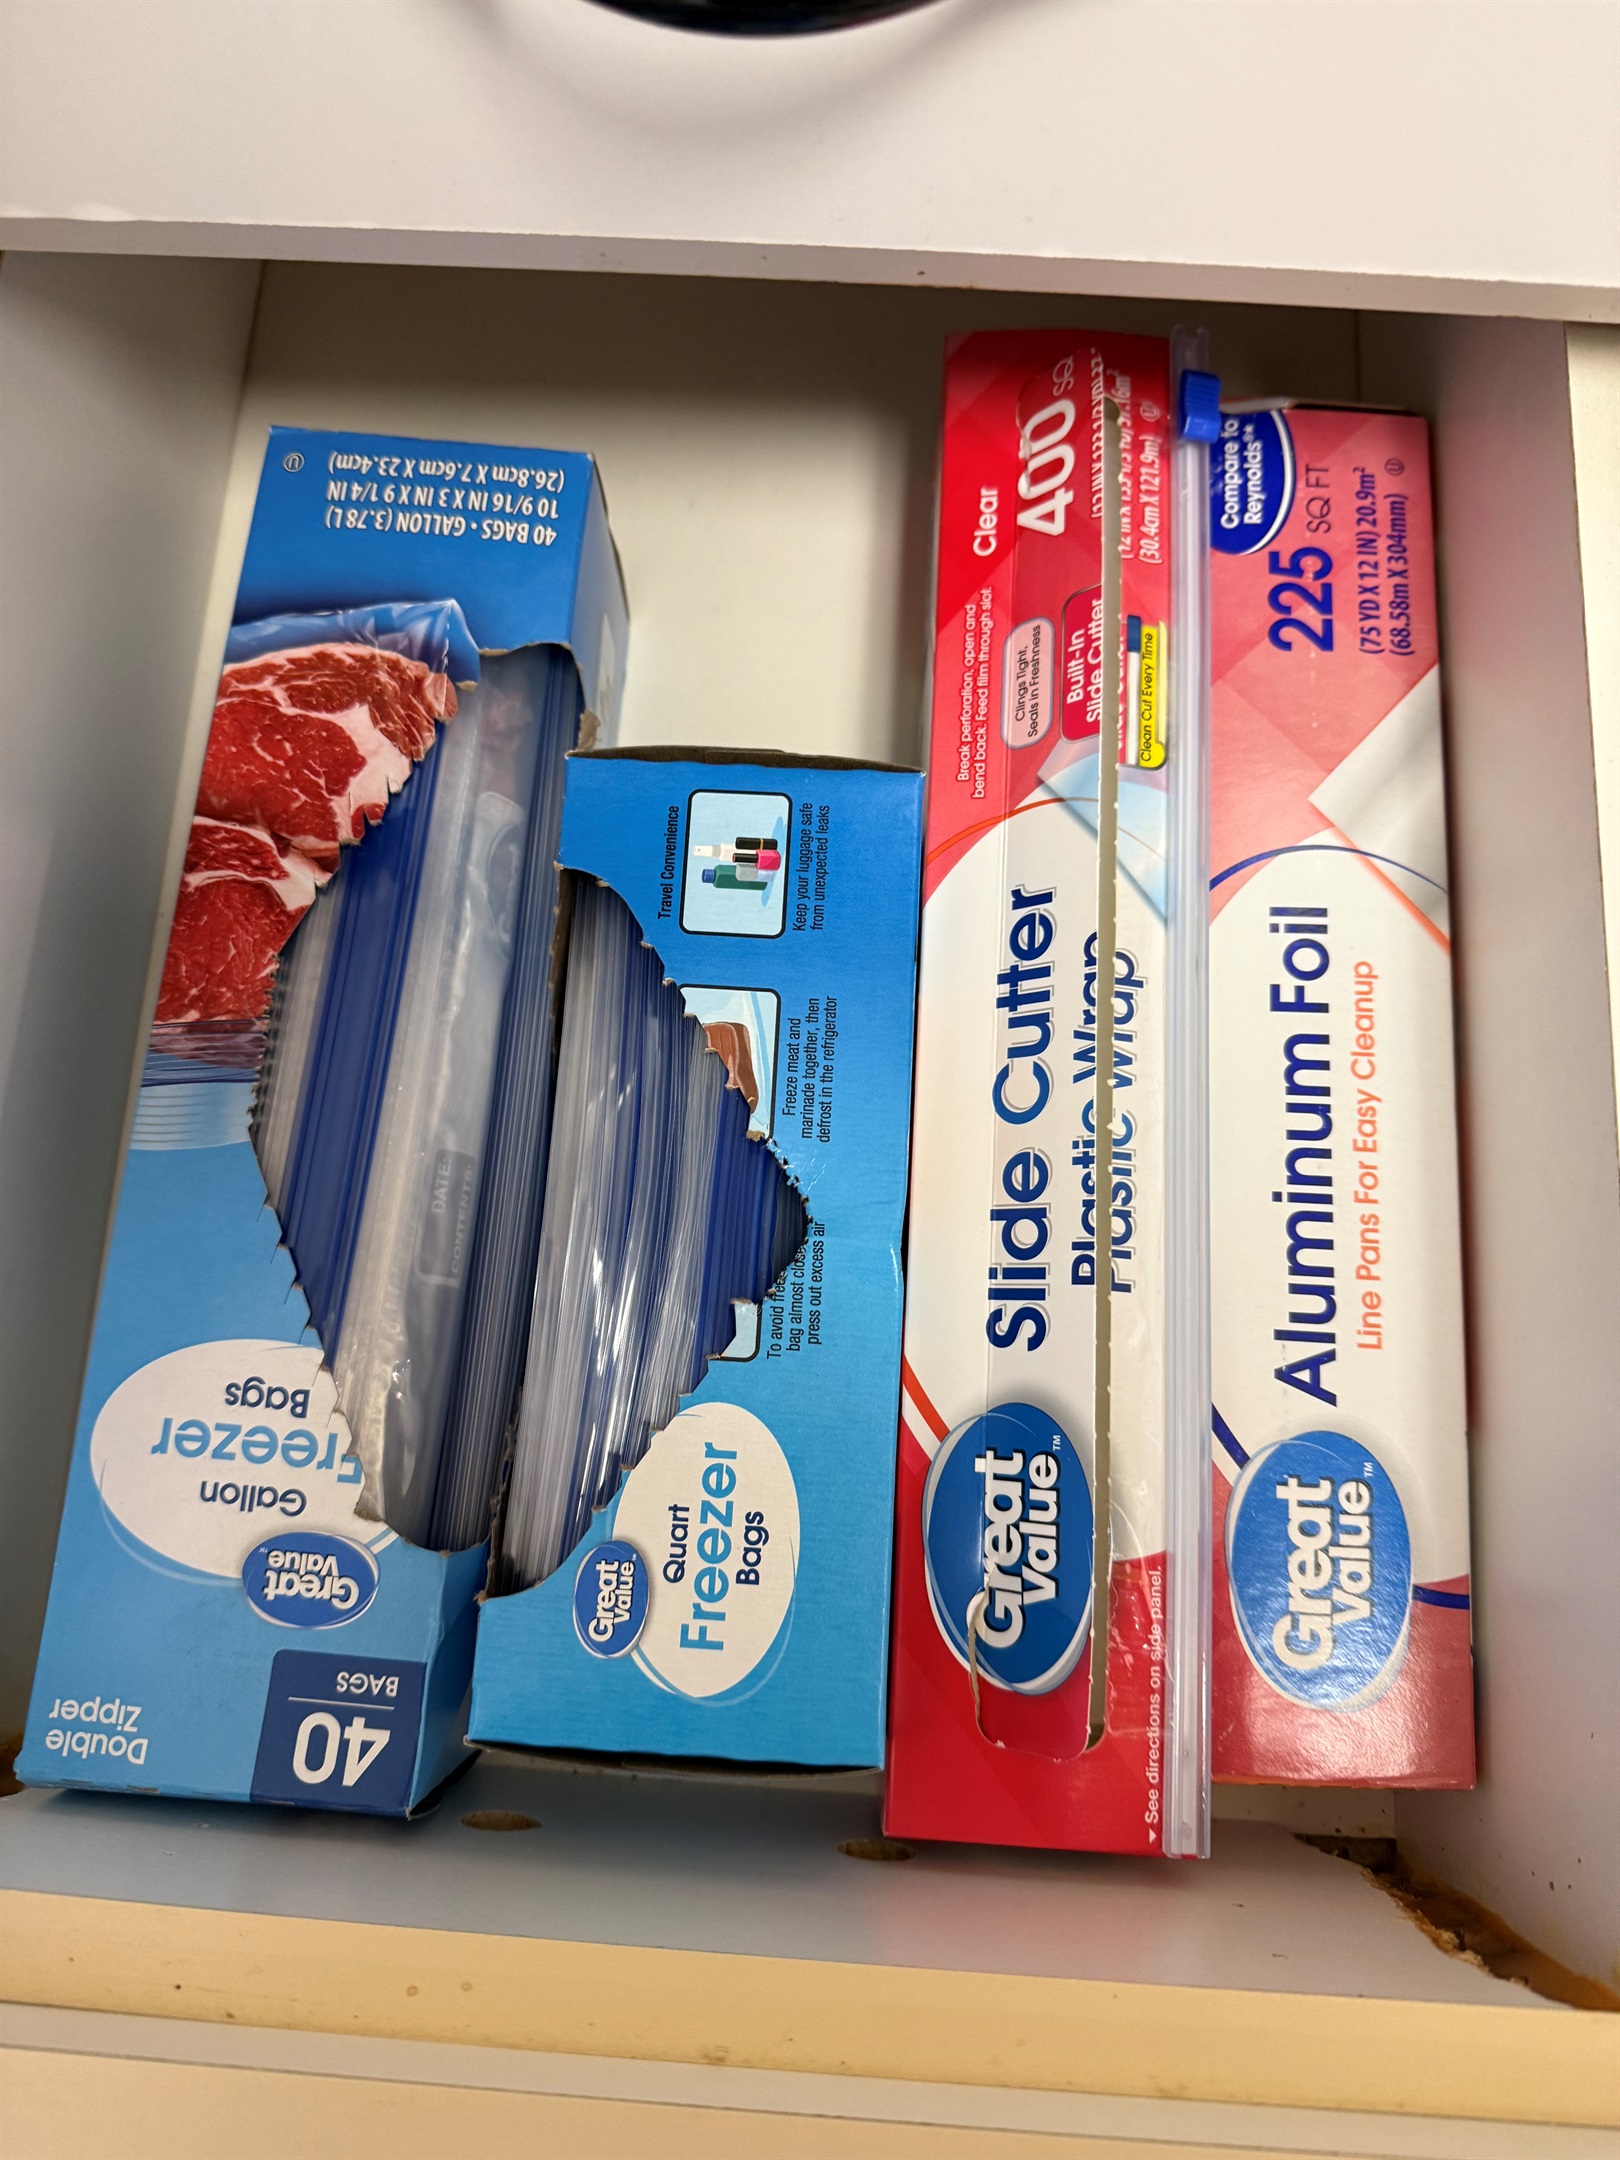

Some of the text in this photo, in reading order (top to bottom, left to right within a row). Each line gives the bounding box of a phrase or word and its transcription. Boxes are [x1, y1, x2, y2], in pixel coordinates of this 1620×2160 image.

[327, 451, 565, 494] (26.8cm X 7.6cm X 23.4cm)
[1016, 355, 1075, 537] 400 SQ
[1220, 418, 1242, 530] Compare to
[326, 480, 559, 519] 10 9/16 IN X 3 IN X 9 1/4 IN
[395, 512, 467, 538] GALLON
[481, 519, 528, 544] BAGS
[533, 526, 557, 546] 40
[973, 486, 998, 557] Clear
[1138, 434, 1163, 565] (30.4cm X 121.9m)
[1267, 463, 1333, 653] 225 SQ FT
[1356, 531, 1380, 556] IN)
[1358, 561, 1379, 581] 12
[1384, 493, 1415, 657] (68.58m X 304mm)
[1358, 585, 1379, 596] X
[1359, 599, 1380, 621] YD
[1066, 628, 1085, 704] Built-In
[1359, 624, 1385, 655] (75
[957, 604, 976, 781] Break perforation, open and
[972, 587, 994, 798] bend back. Feed film through slot.
[1015, 645, 1029, 722] Clings Tight,
[1028, 625, 1041, 737] Seals in Freshness
[1140, 632, 1155, 762] Clean Cut Every Time
[657, 805, 680, 919] Travel Convenience
[792, 802, 814, 932] Keep your luggage safe
[810, 805, 830, 931] from unexpected leaks
[782, 1018, 801, 1116] Freeze meat and
[800, 998, 820, 1139] marinade together, then
[816, 995, 839, 1143] defrost in the refrigerator
[985, 883, 1058, 1352] Slide Cutter
[1350, 960, 1383, 1351] Line Pans For Easy Cleanup
[431, 1158, 452, 1214] DATE:
[1268, 906, 1338, 1408] Aluminum Foil
[451, 1164, 475, 1274] CONTENTS:
[788, 1281, 804, 1324] almost
[807, 1221, 825, 1345] press out excess air
[766, 1344, 782, 1360] To
[769, 1306, 785, 1340] avoid
[786, 1328, 804, 1352] bag
[224, 1376, 311, 1418] Bags
[150, 1417, 364, 1485] Freezer
[199, 1480, 307, 1517] Gallon
[1022, 1452, 1061, 1607] Value
[266, 1549, 340, 1577] Value
[662, 1504, 690, 1584] Quart
[679, 1441, 738, 1651] Freezer
[735, 1511, 769, 1586] Bags
[966, 1447, 1027, 1650] Great
[1272, 1474, 1336, 1670] Great
[1329, 1479, 1373, 1626] Value
[263, 1569, 360, 1610] Great
[588, 1559, 620, 1642] Great
[614, 1560, 636, 1623] Value
[49, 1696, 142, 1733] Zipper
[336, 1671, 400, 1698] BAGS
[1144, 1564, 1165, 1824] See directions on side panel.
[45, 1728, 149, 1765] Double
[292, 1711, 391, 1788] 40
